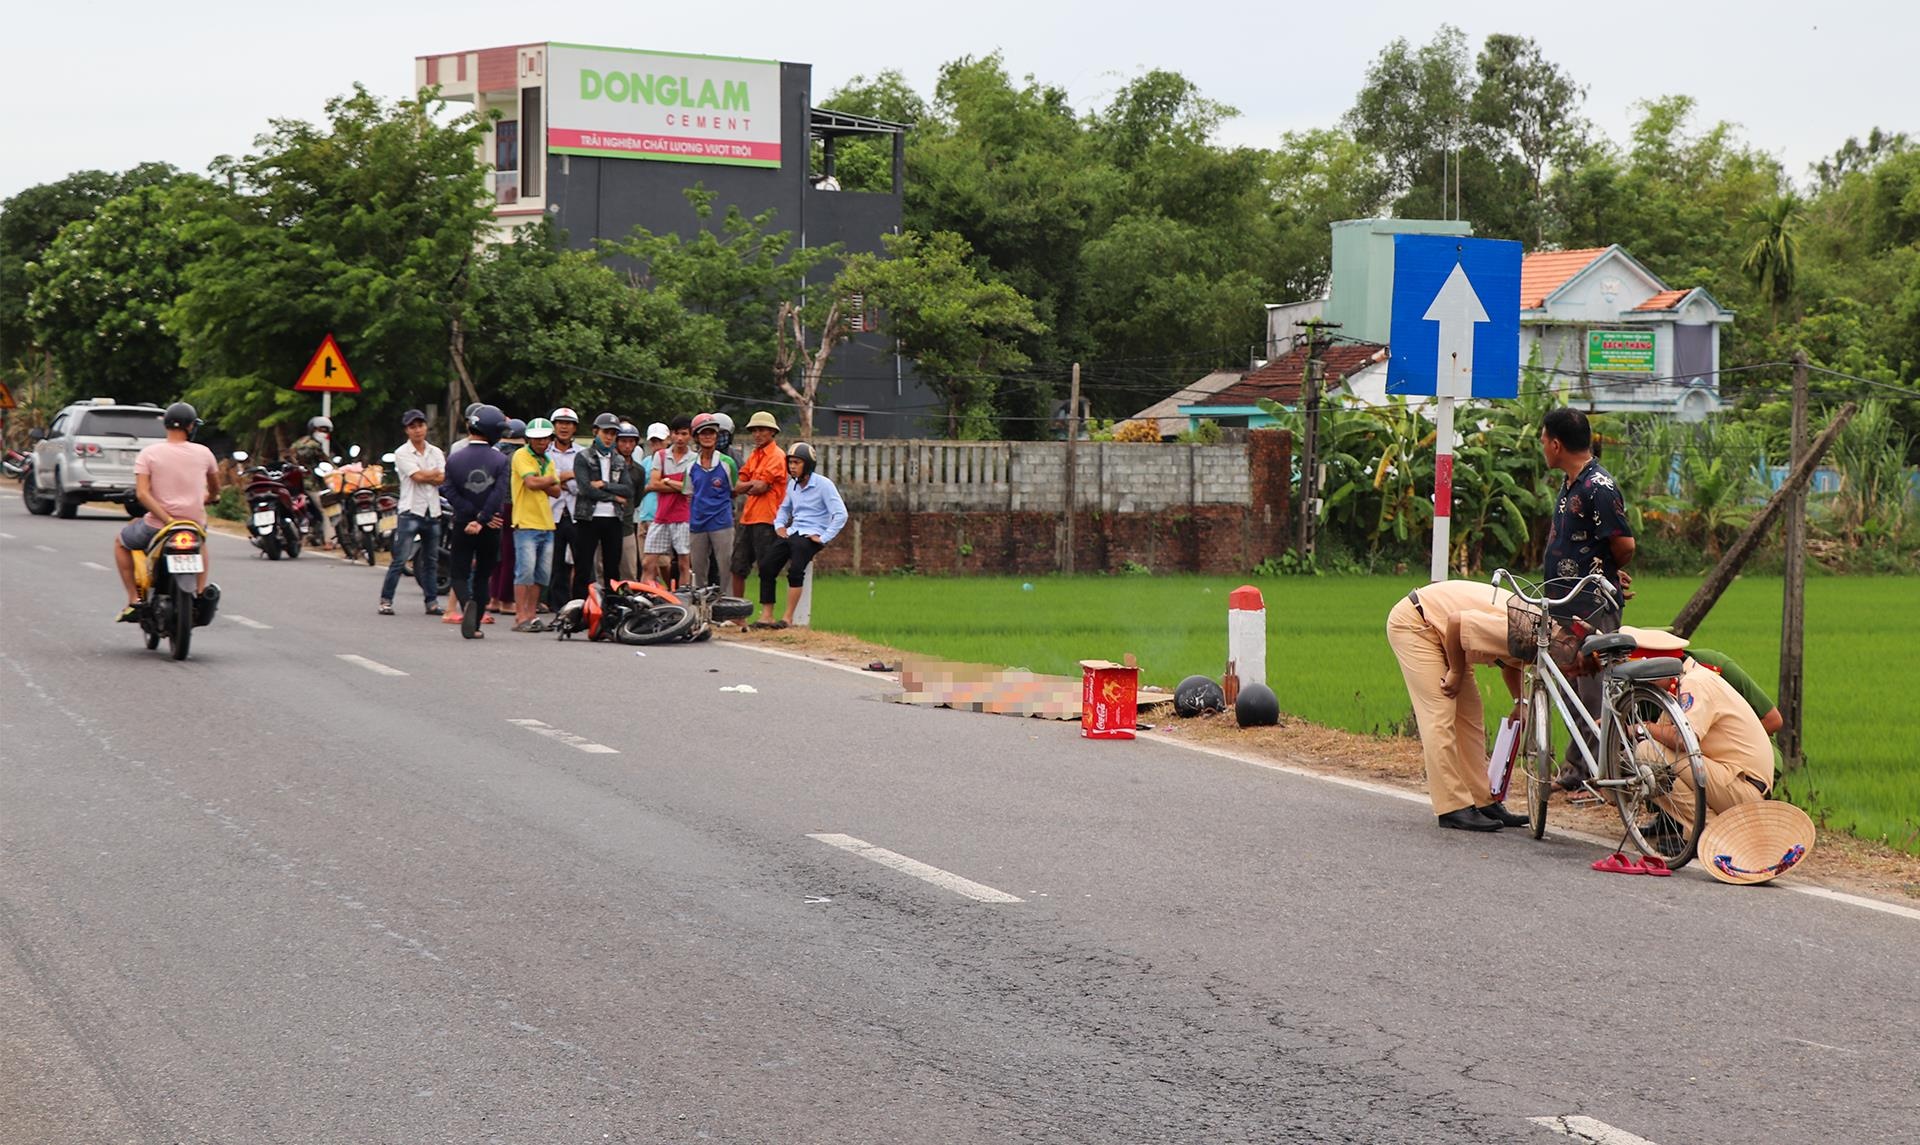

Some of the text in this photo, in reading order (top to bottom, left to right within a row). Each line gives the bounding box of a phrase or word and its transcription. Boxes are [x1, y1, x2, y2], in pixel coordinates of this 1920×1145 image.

[579, 68, 750, 112] DONGLAM
[666, 113, 751, 131] CEMENT
[581, 133, 602, 147] TRẢI
[603, 137, 641, 149] NGHIỆM
